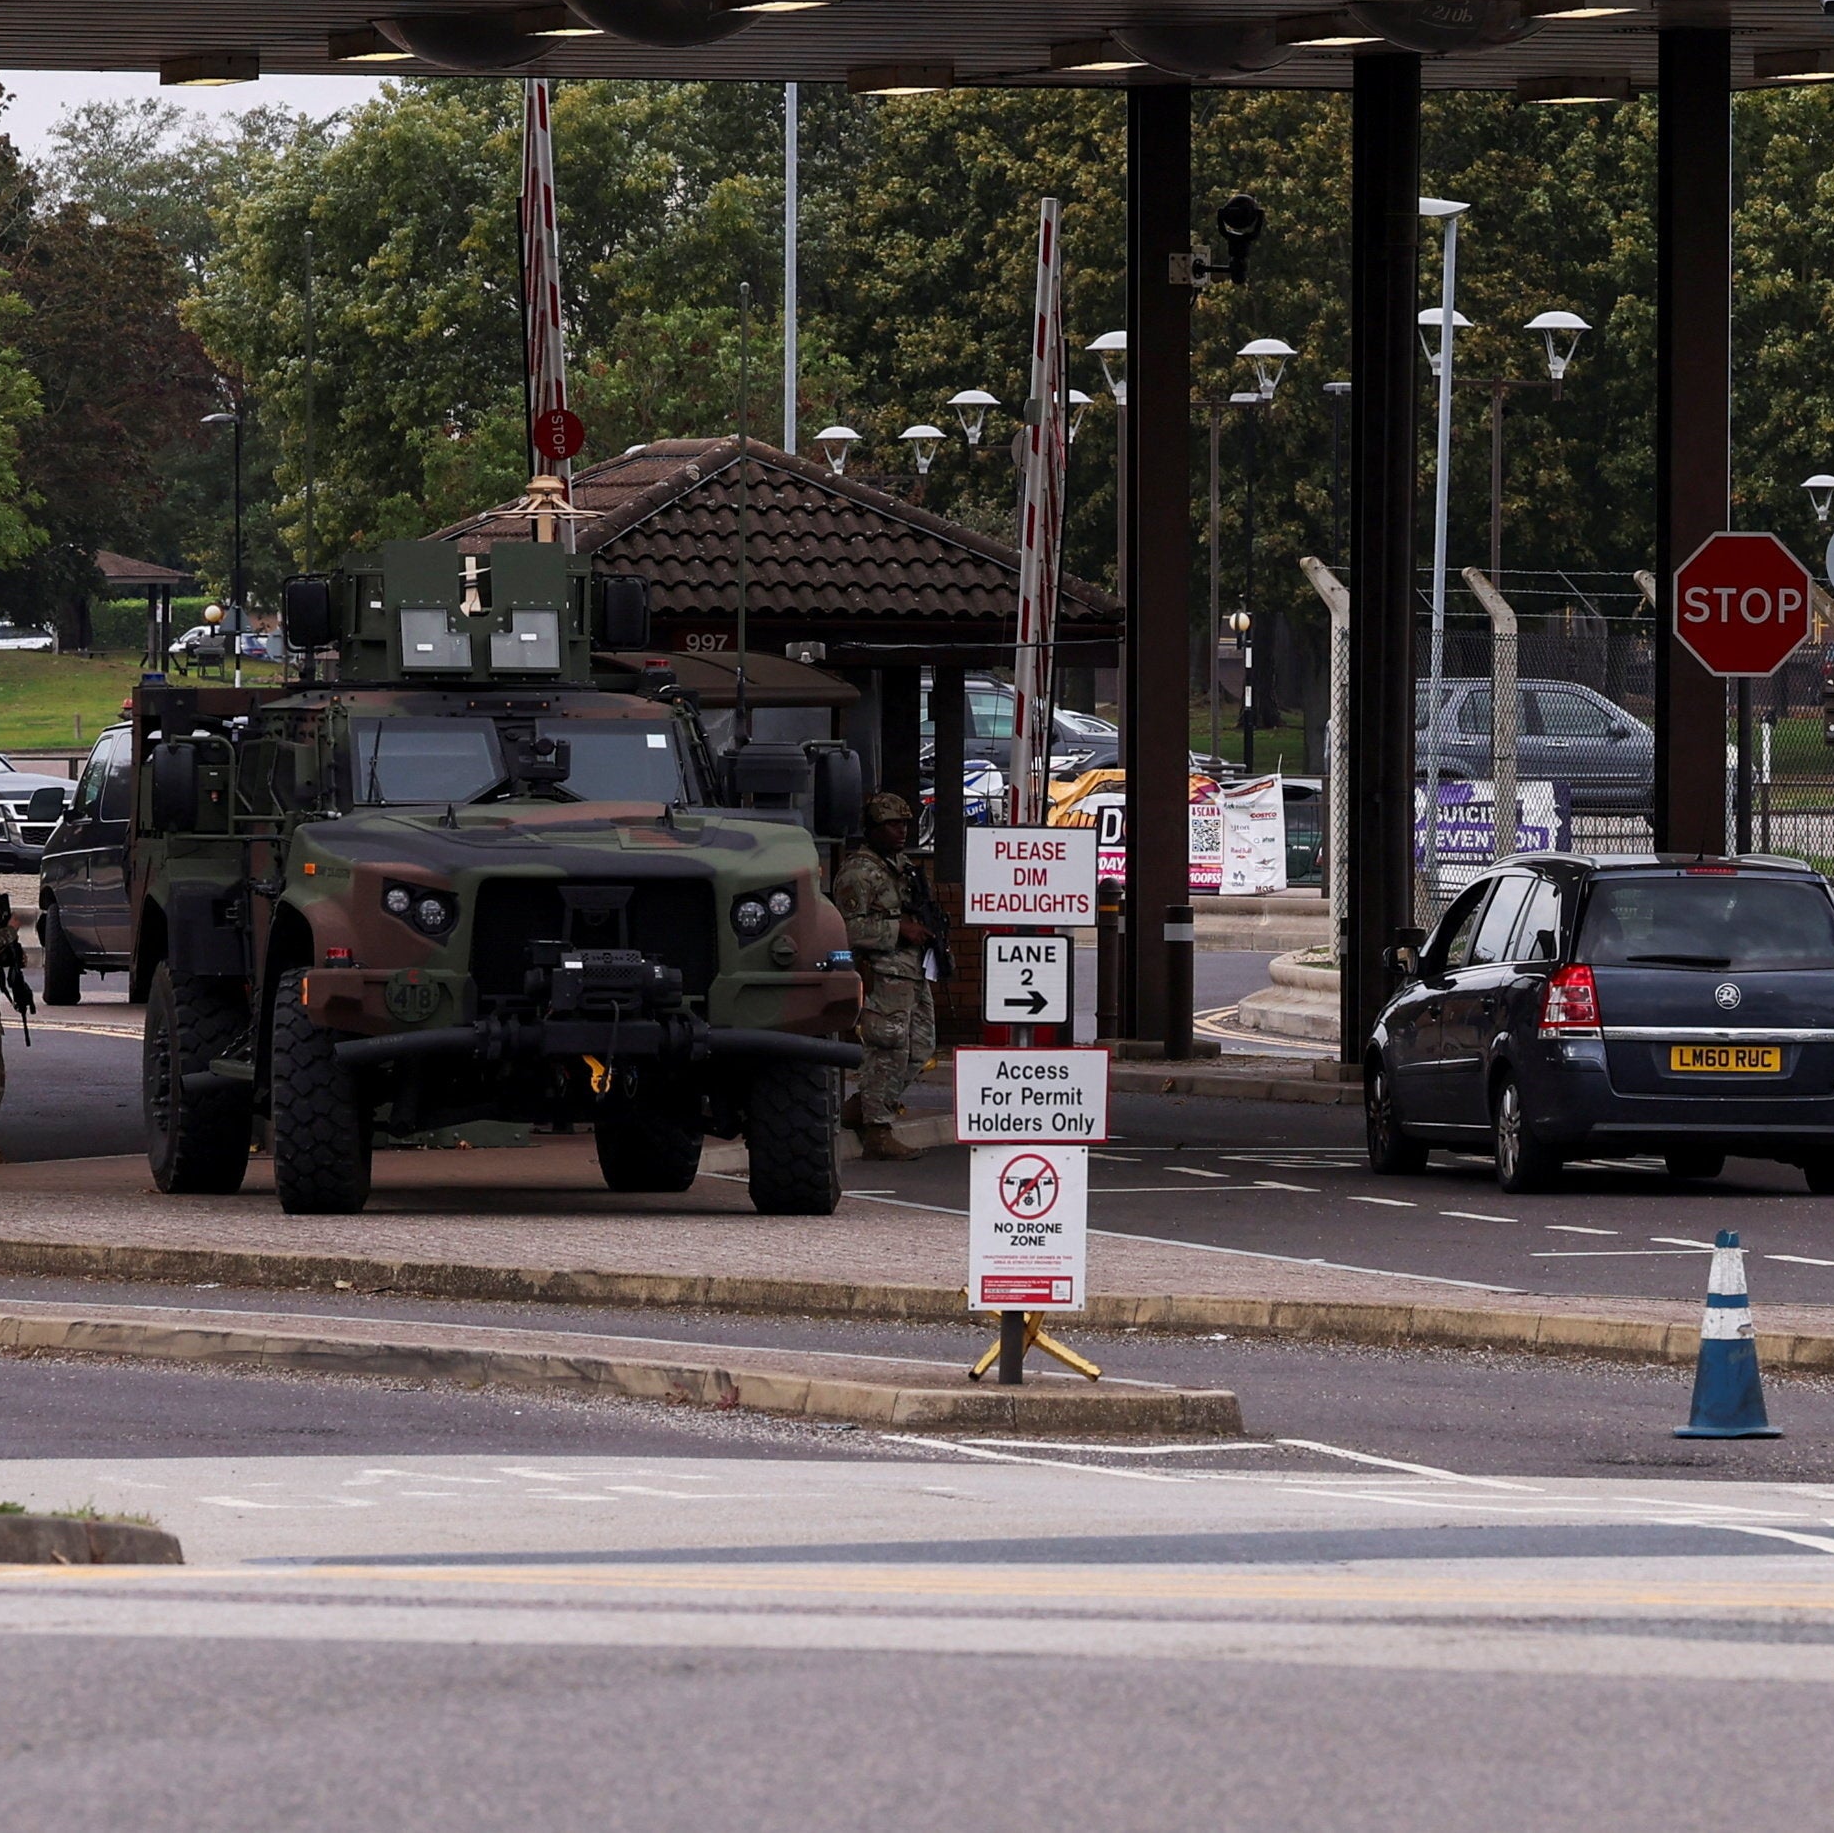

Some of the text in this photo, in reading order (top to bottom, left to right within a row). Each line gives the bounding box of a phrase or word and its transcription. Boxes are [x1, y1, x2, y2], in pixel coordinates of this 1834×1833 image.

[551, 415, 566, 455] STOP
[1683, 586, 1802, 624] STOP
[685, 633, 728, 653] 997
[1197, 806, 1215, 817] SCAN
[995, 841, 1066, 861] PLEASE
[1013, 868, 1047, 886] DIM
[971, 893, 1089, 913] HEADLIGHTS
[997, 945, 1056, 963] LANE
[1020, 968, 1033, 986] 2
[1679, 1048, 1772, 1068] LM60 RUC
[996, 1061, 1069, 1080] Access
[981, 1086, 1083, 1106] For Permit
[968, 1113, 1095, 1135] Holders Only
[994, 1223, 1063, 1234] NO DRONE
[1010, 1235, 1046, 1247] ZONE
